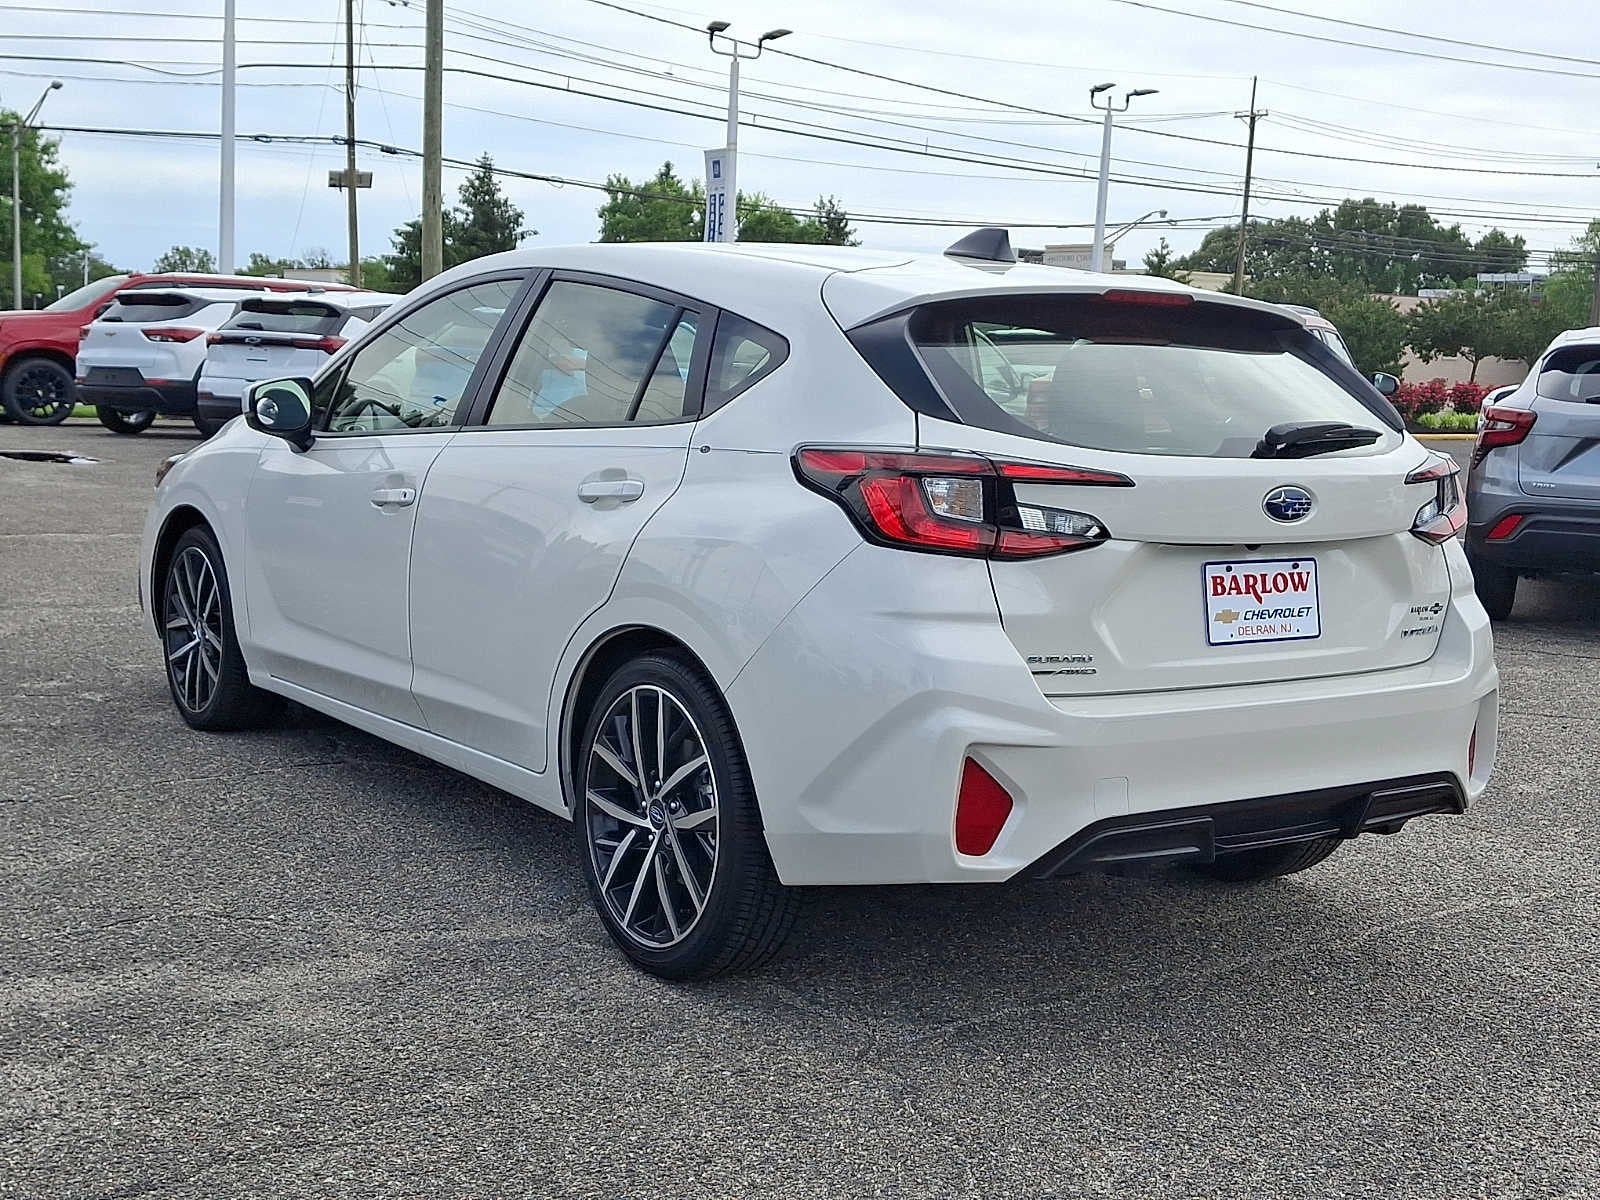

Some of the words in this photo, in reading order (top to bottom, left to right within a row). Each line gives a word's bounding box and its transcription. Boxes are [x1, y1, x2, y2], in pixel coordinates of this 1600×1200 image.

[1211, 571, 1311, 605] BARLOW
[1243, 606, 1313, 621] CHEVROLET
[1238, 624, 1279, 636] DELRAN,
[1280, 623, 1292, 633] NJ
[1027, 654, 1094, 663] SUBARU
